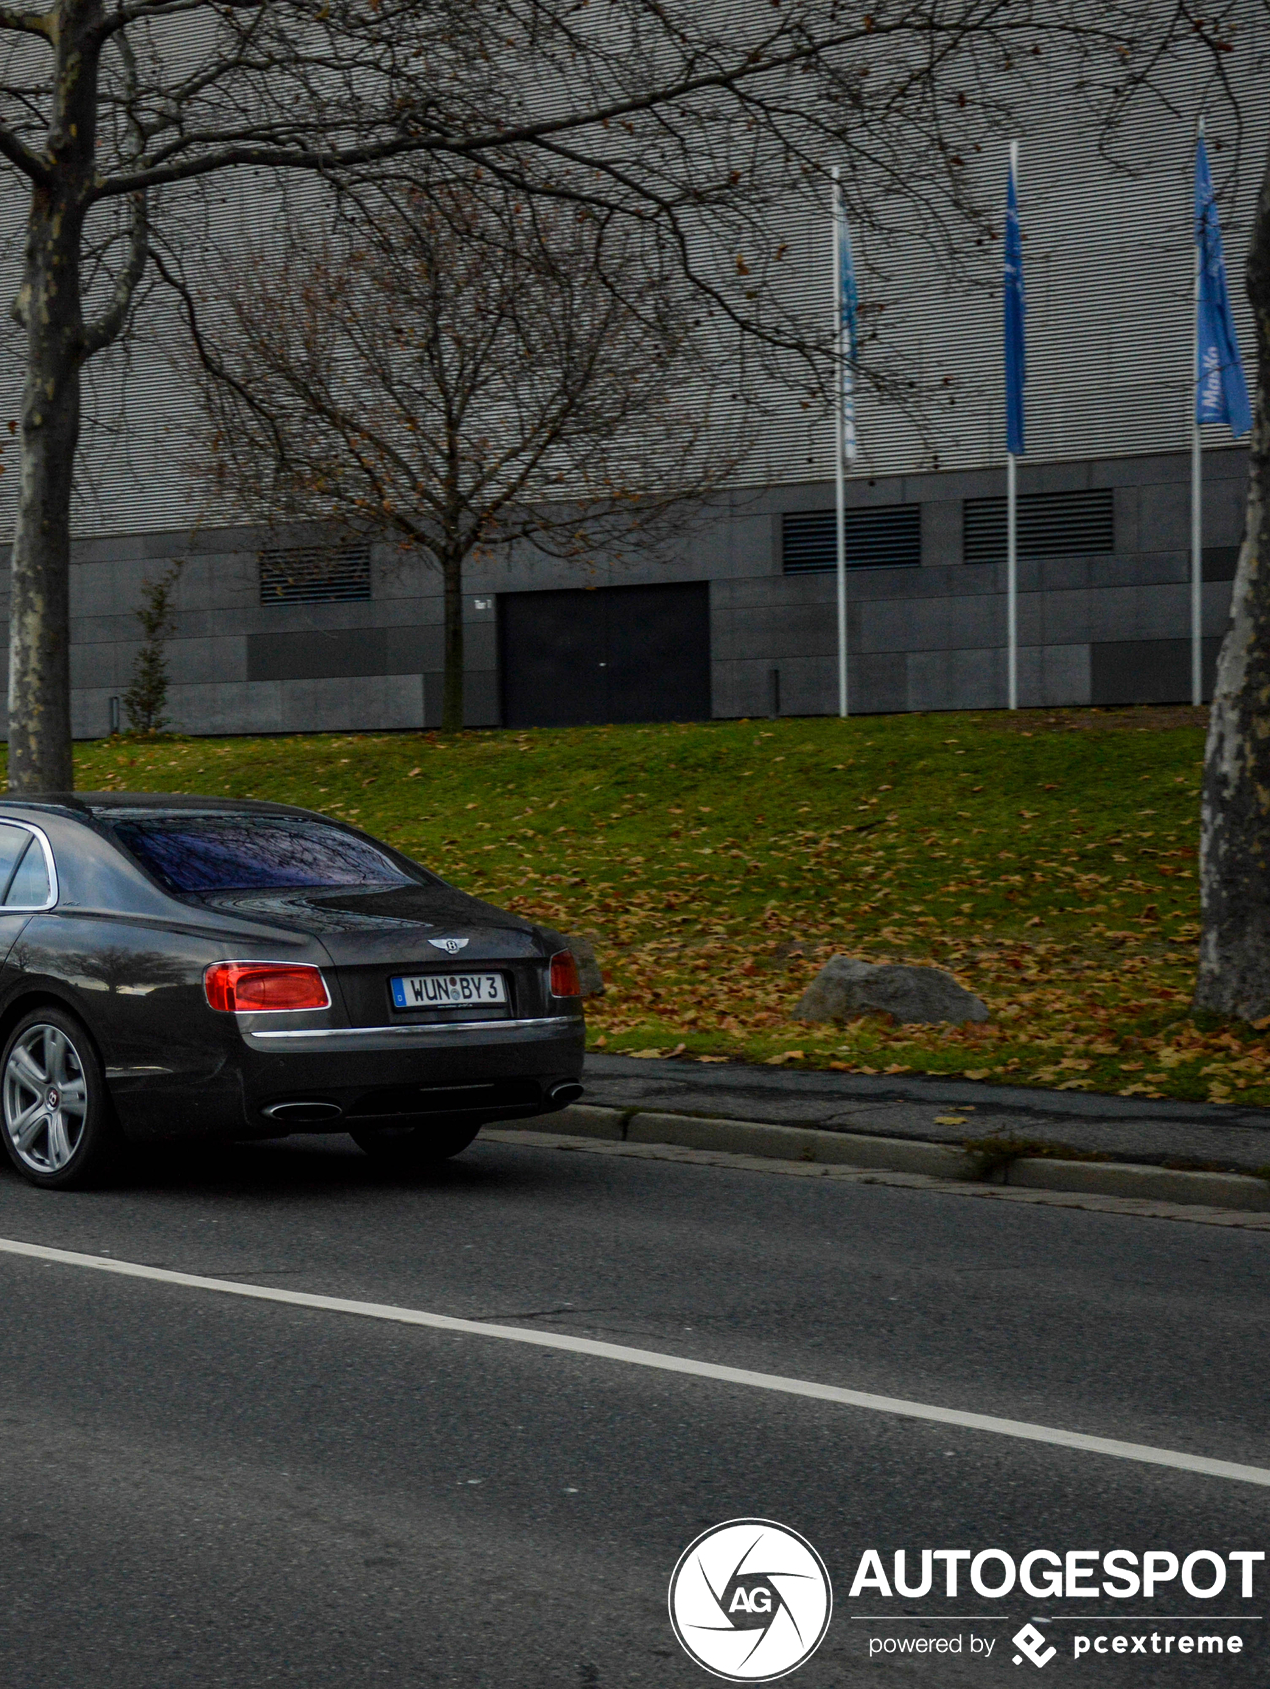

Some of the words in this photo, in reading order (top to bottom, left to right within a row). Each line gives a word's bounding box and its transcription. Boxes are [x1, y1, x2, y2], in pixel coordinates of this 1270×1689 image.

[411, 978, 450, 1001] WUN
[459, 977, 482, 999] BY
[486, 976, 498, 998] 3
